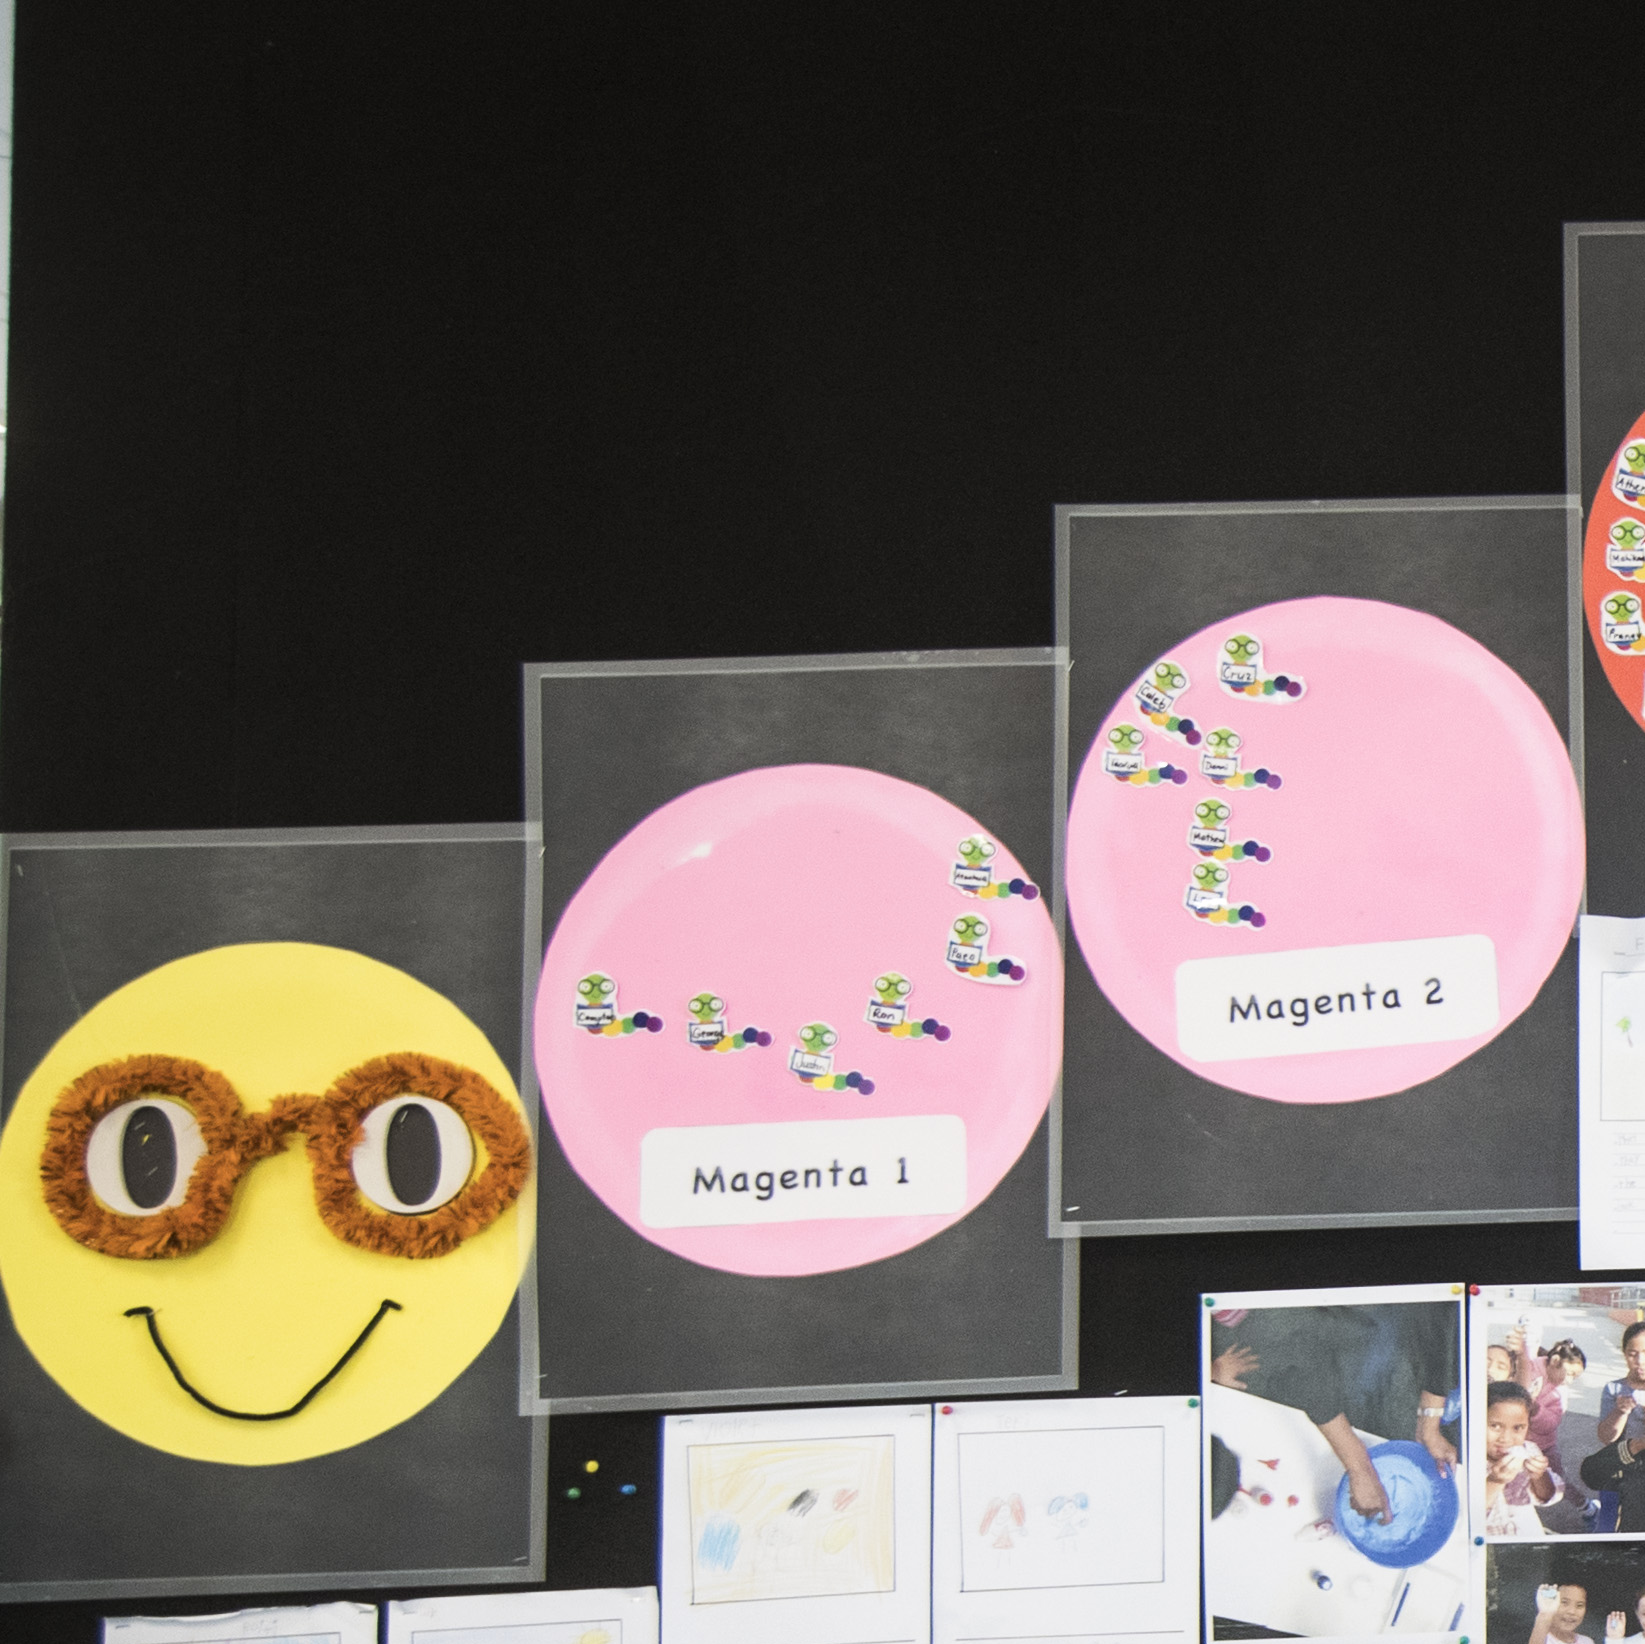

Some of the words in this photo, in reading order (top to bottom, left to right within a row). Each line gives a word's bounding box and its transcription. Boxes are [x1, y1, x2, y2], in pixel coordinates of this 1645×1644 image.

[1223, 665, 1253, 681] Cruz
[1139, 686, 1166, 710] Caleb
[872, 1007, 896, 1021] Ron
[1230, 984, 1401, 1026] Magenta
[1426, 978, 1443, 1004] 2
[694, 1161, 867, 1201] Magenta
[898, 1158, 908, 1184] 1
